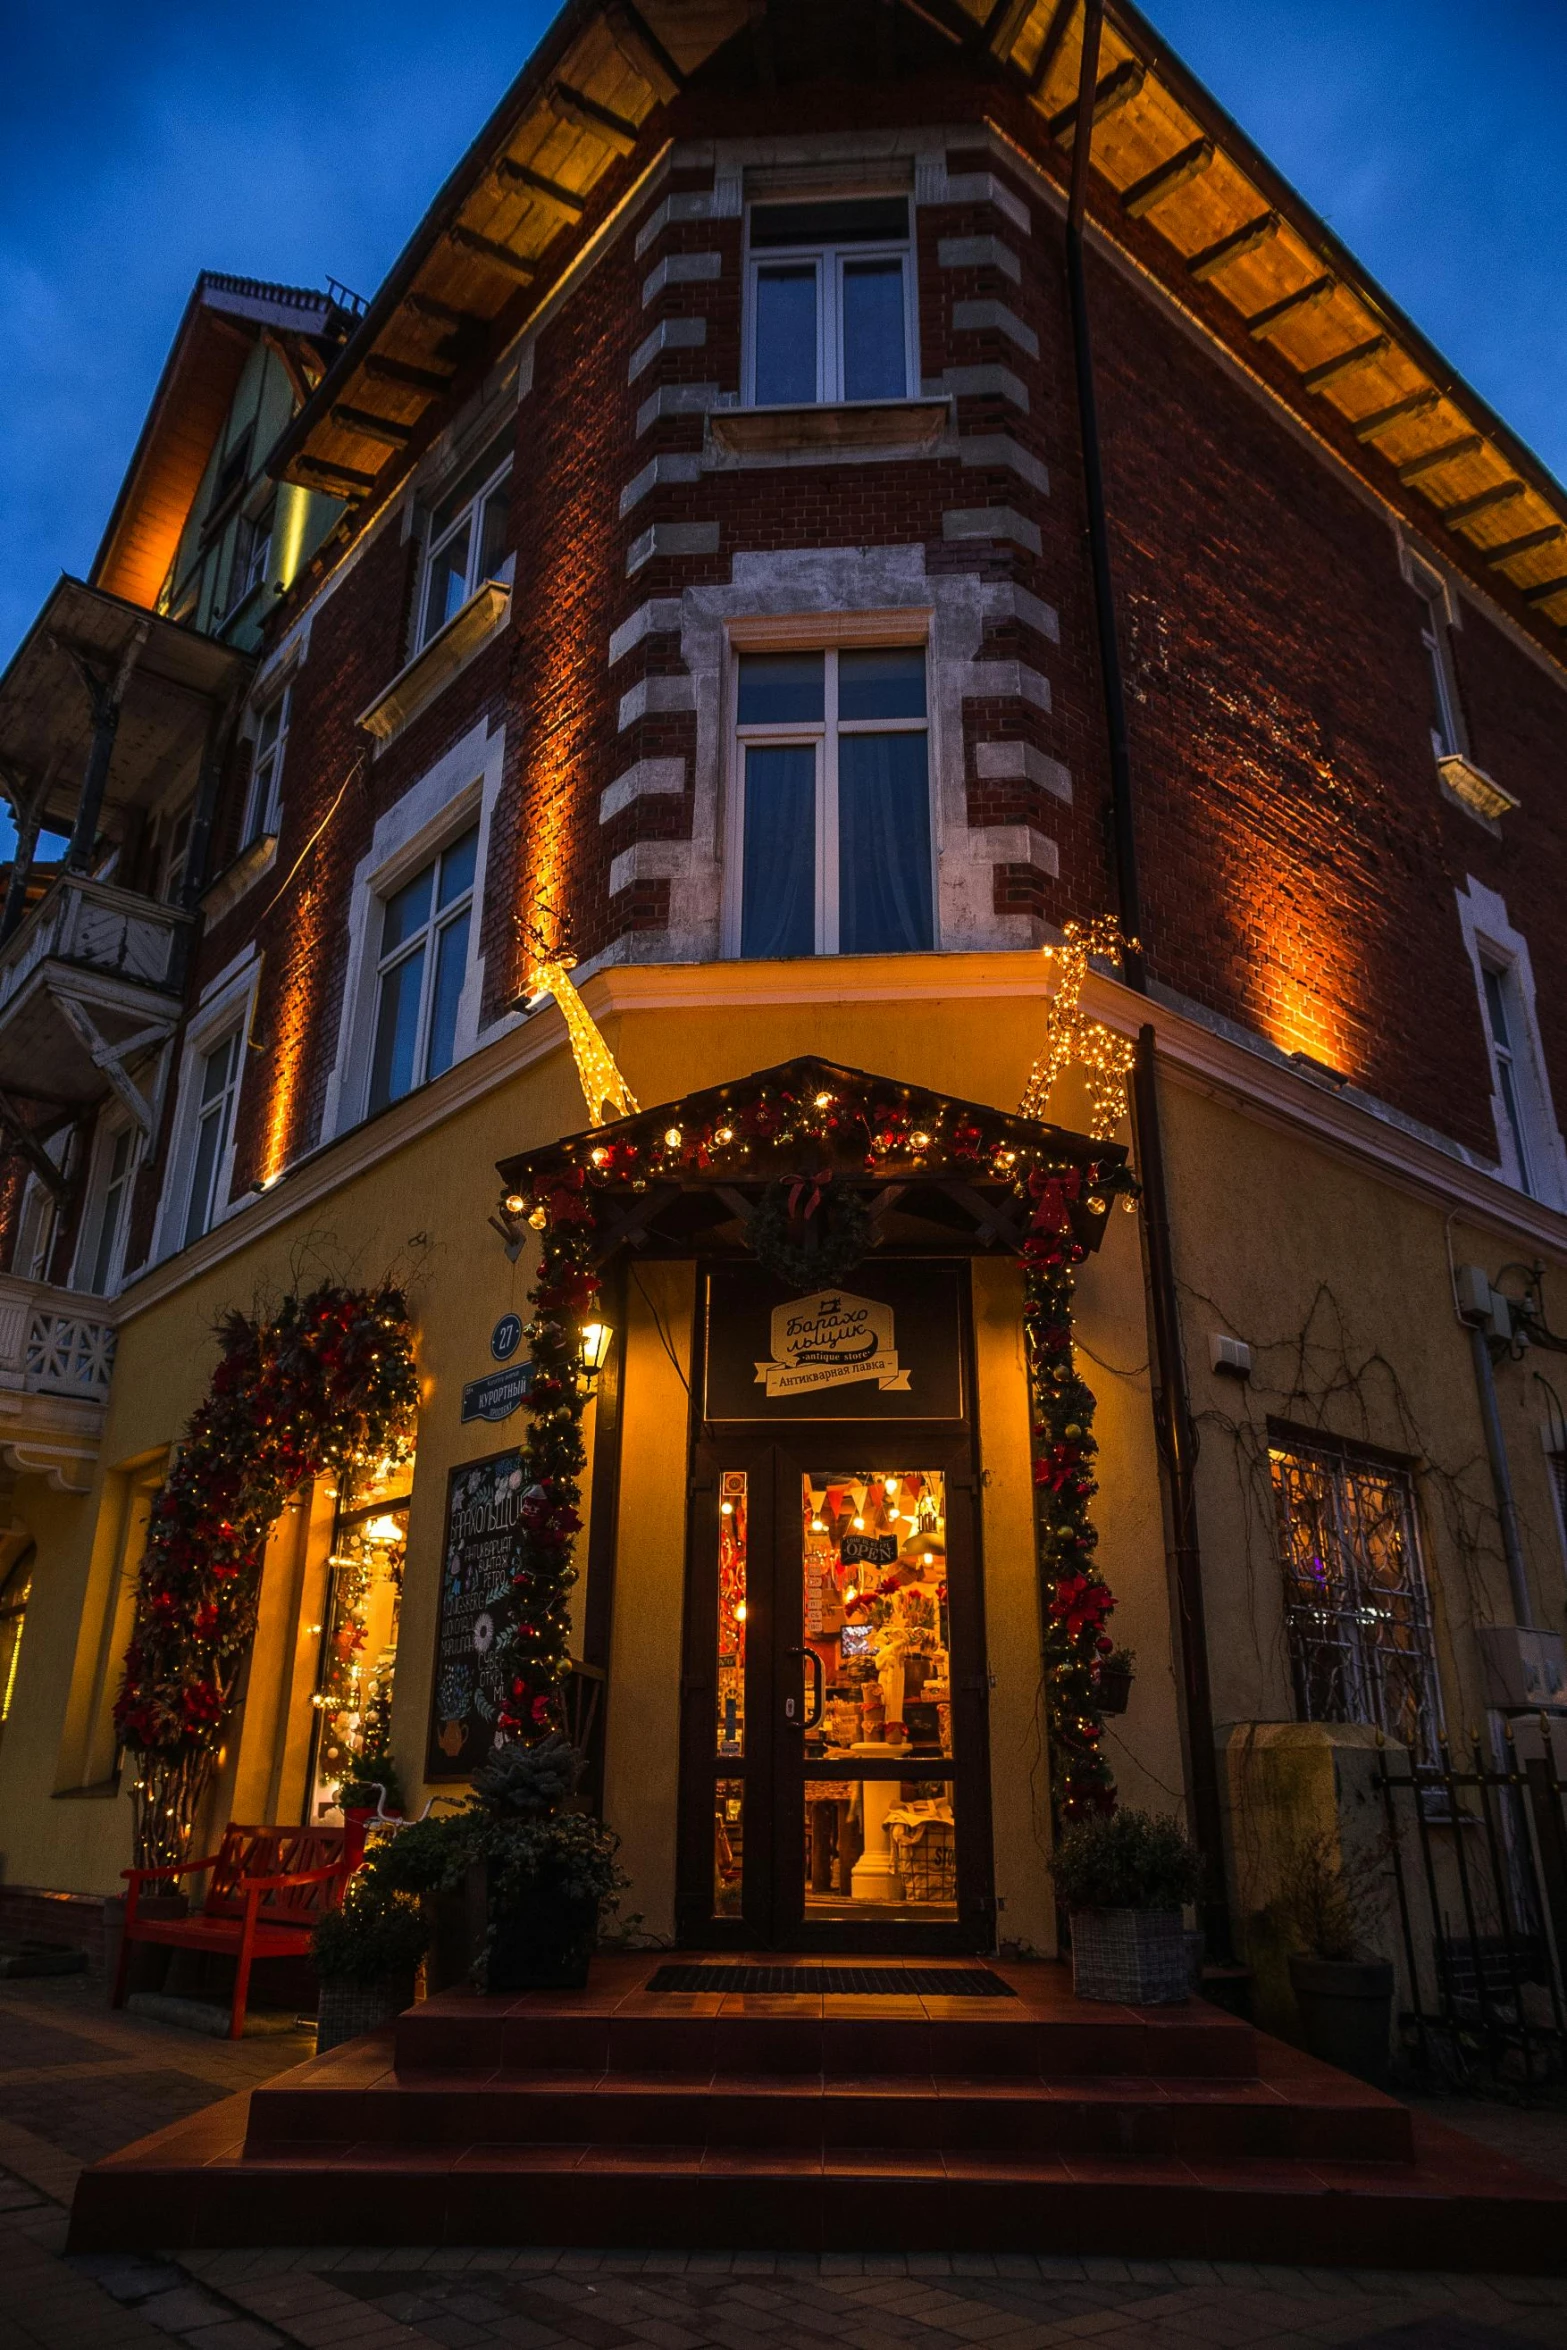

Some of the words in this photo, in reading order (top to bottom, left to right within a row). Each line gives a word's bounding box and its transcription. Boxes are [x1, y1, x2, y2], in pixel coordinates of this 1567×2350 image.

[786, 1309, 868, 1340] Барахо
[498, 1324, 513, 1350] 27
[805, 1351, 840, 1362] antique
[844, 1350, 870, 1361] store
[779, 1367, 850, 1386] Антикварная
[852, 1360, 885, 1373] лавка
[846, 1543, 892, 1561] OPEN
[483, 1569, 506, 1588] РЕТРО
